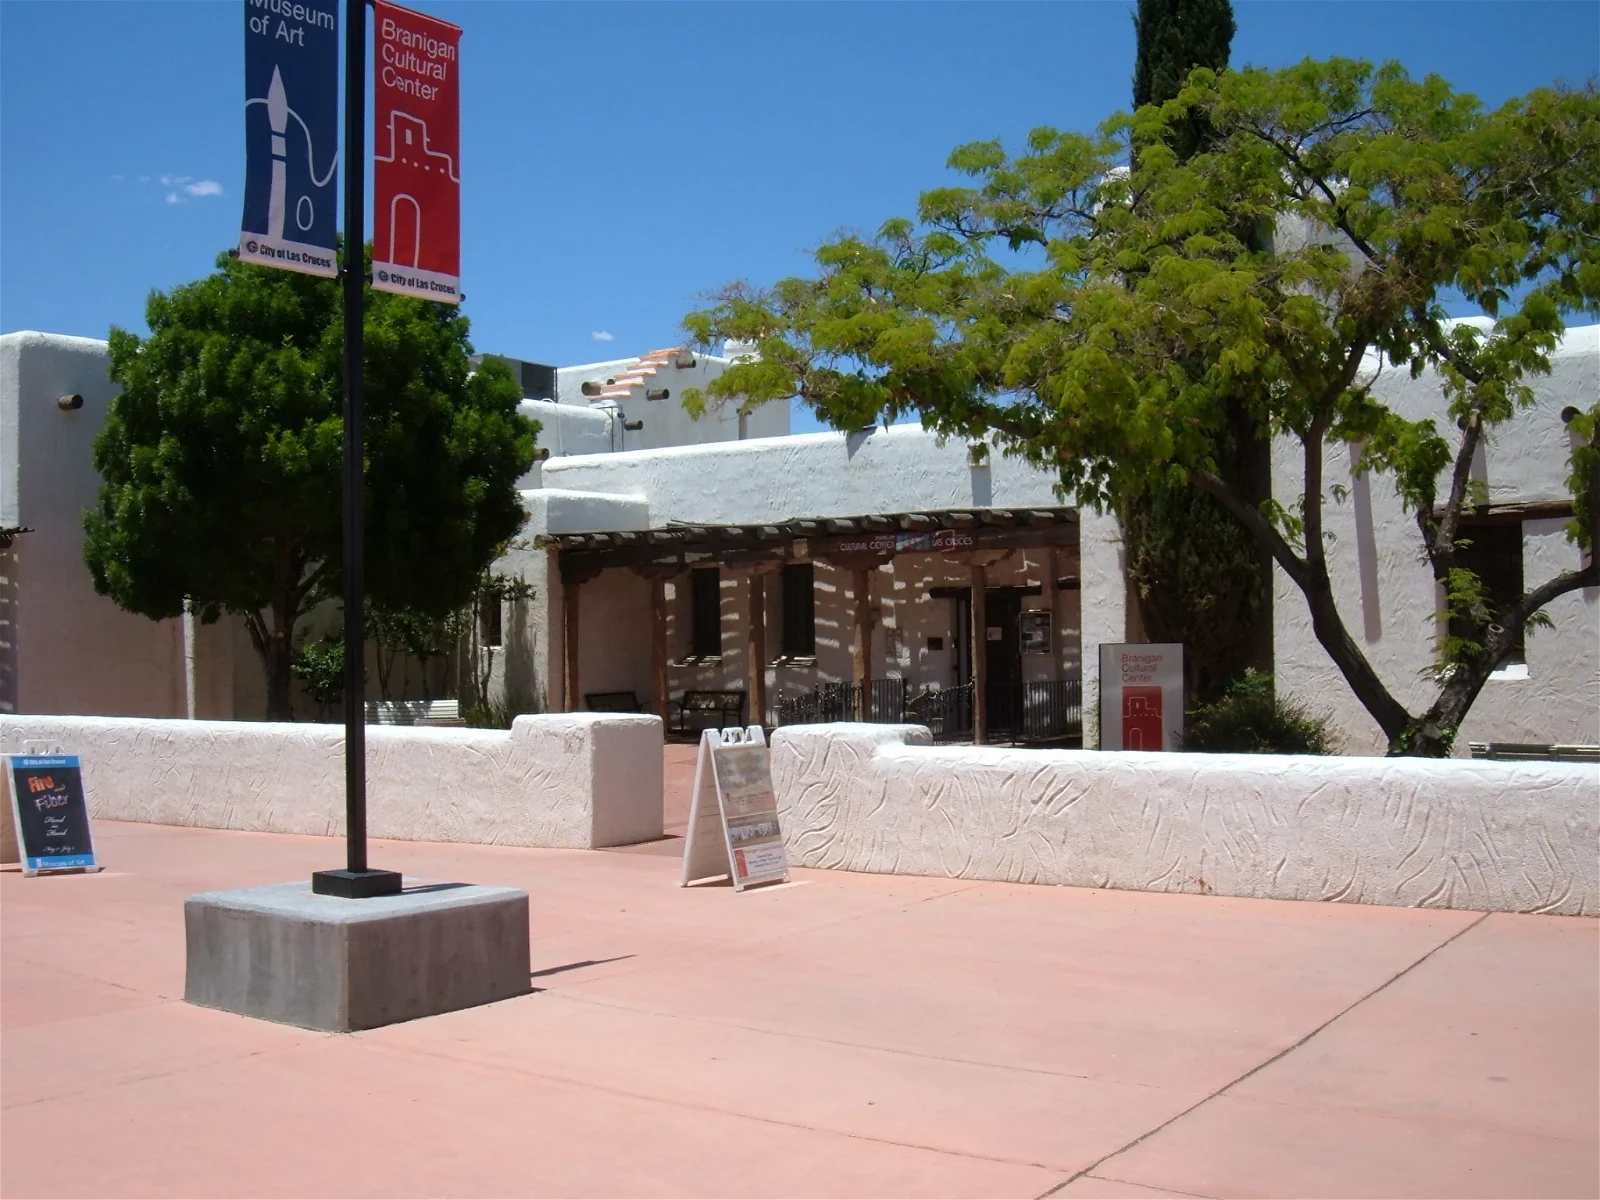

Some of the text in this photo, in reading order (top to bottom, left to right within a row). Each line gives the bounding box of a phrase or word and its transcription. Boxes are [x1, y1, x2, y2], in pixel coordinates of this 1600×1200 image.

[250, 15, 305, 47] of Art
[381, 18, 456, 61] Branigan
[381, 44, 447, 81] Cultural
[381, 66, 439, 101] Center
[260, 244, 332, 268] City of Las Cruces
[390, 273, 456, 295] City of Las Cruces
[1121, 653, 1163, 664] Branigan
[1121, 663, 1157, 673] Cultural
[1121, 673, 1153, 683] Center
[35, 794, 69, 811] Fiber
